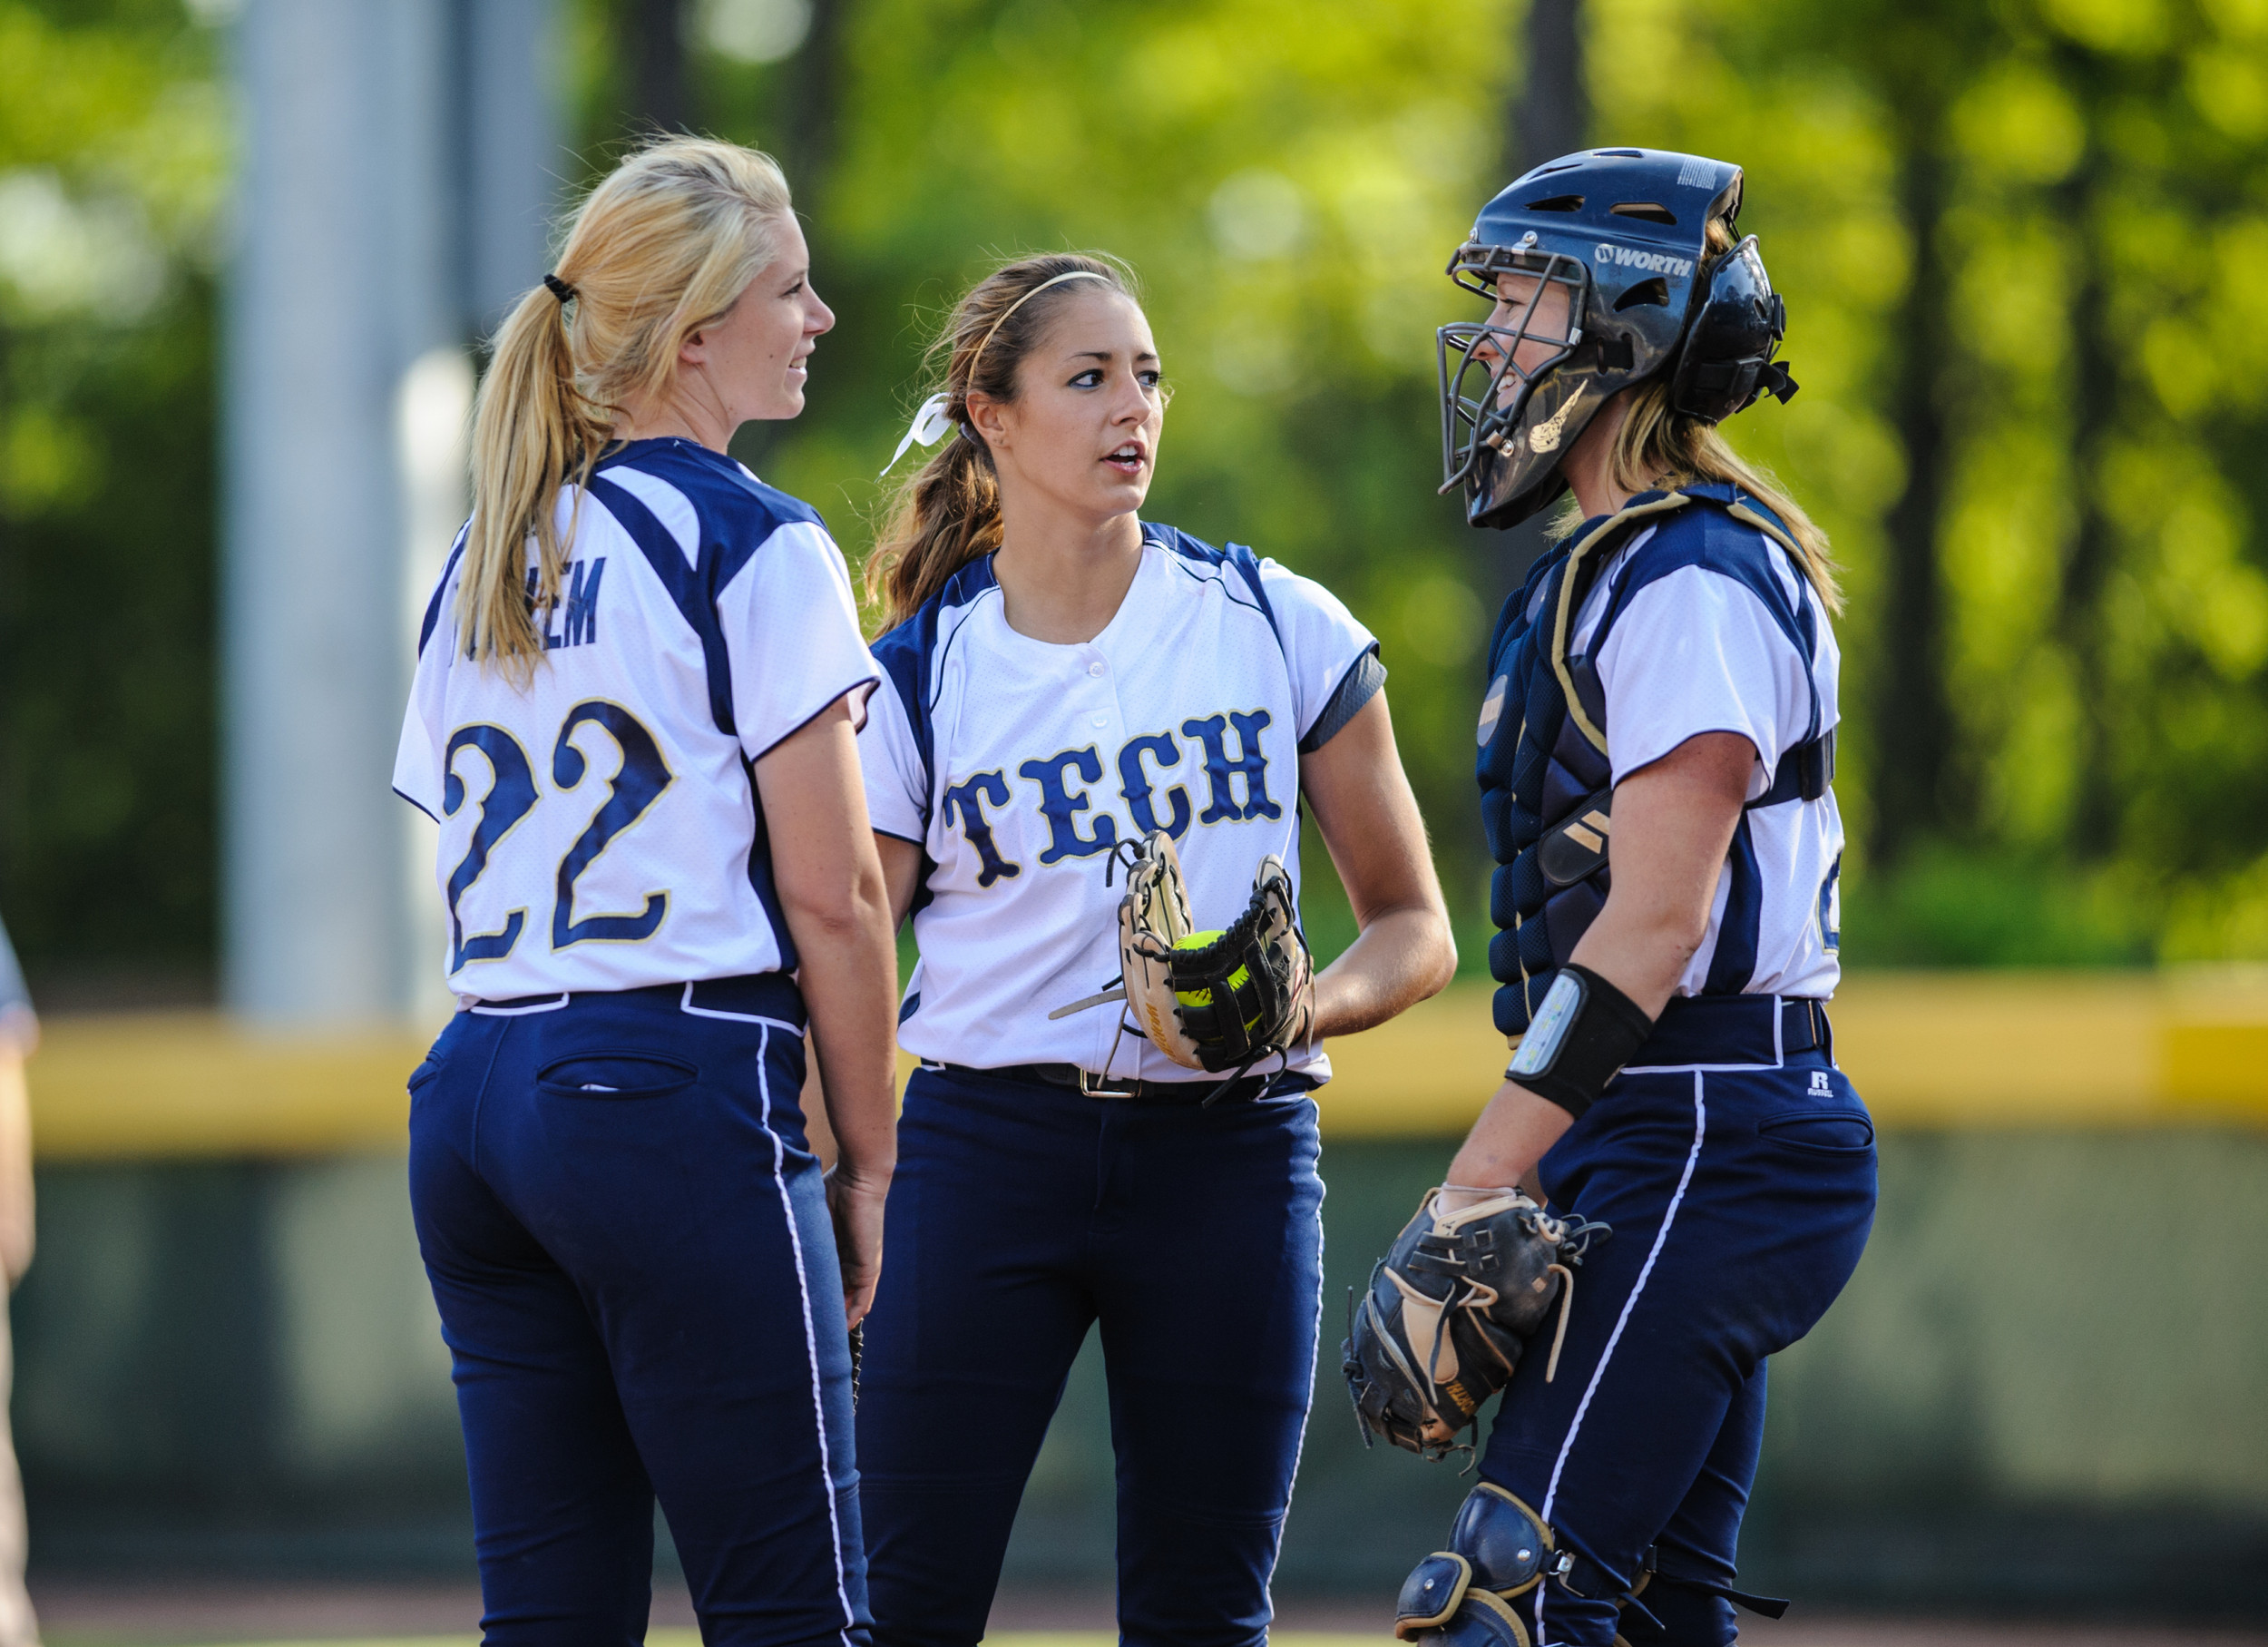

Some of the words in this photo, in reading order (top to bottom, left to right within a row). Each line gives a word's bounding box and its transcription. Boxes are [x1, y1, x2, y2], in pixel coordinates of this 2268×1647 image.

[1615, 247, 1693, 277] WORTH
[443, 695, 680, 979] 22
[942, 707, 1284, 890] TECH
[1811, 1071, 1828, 1090] R
